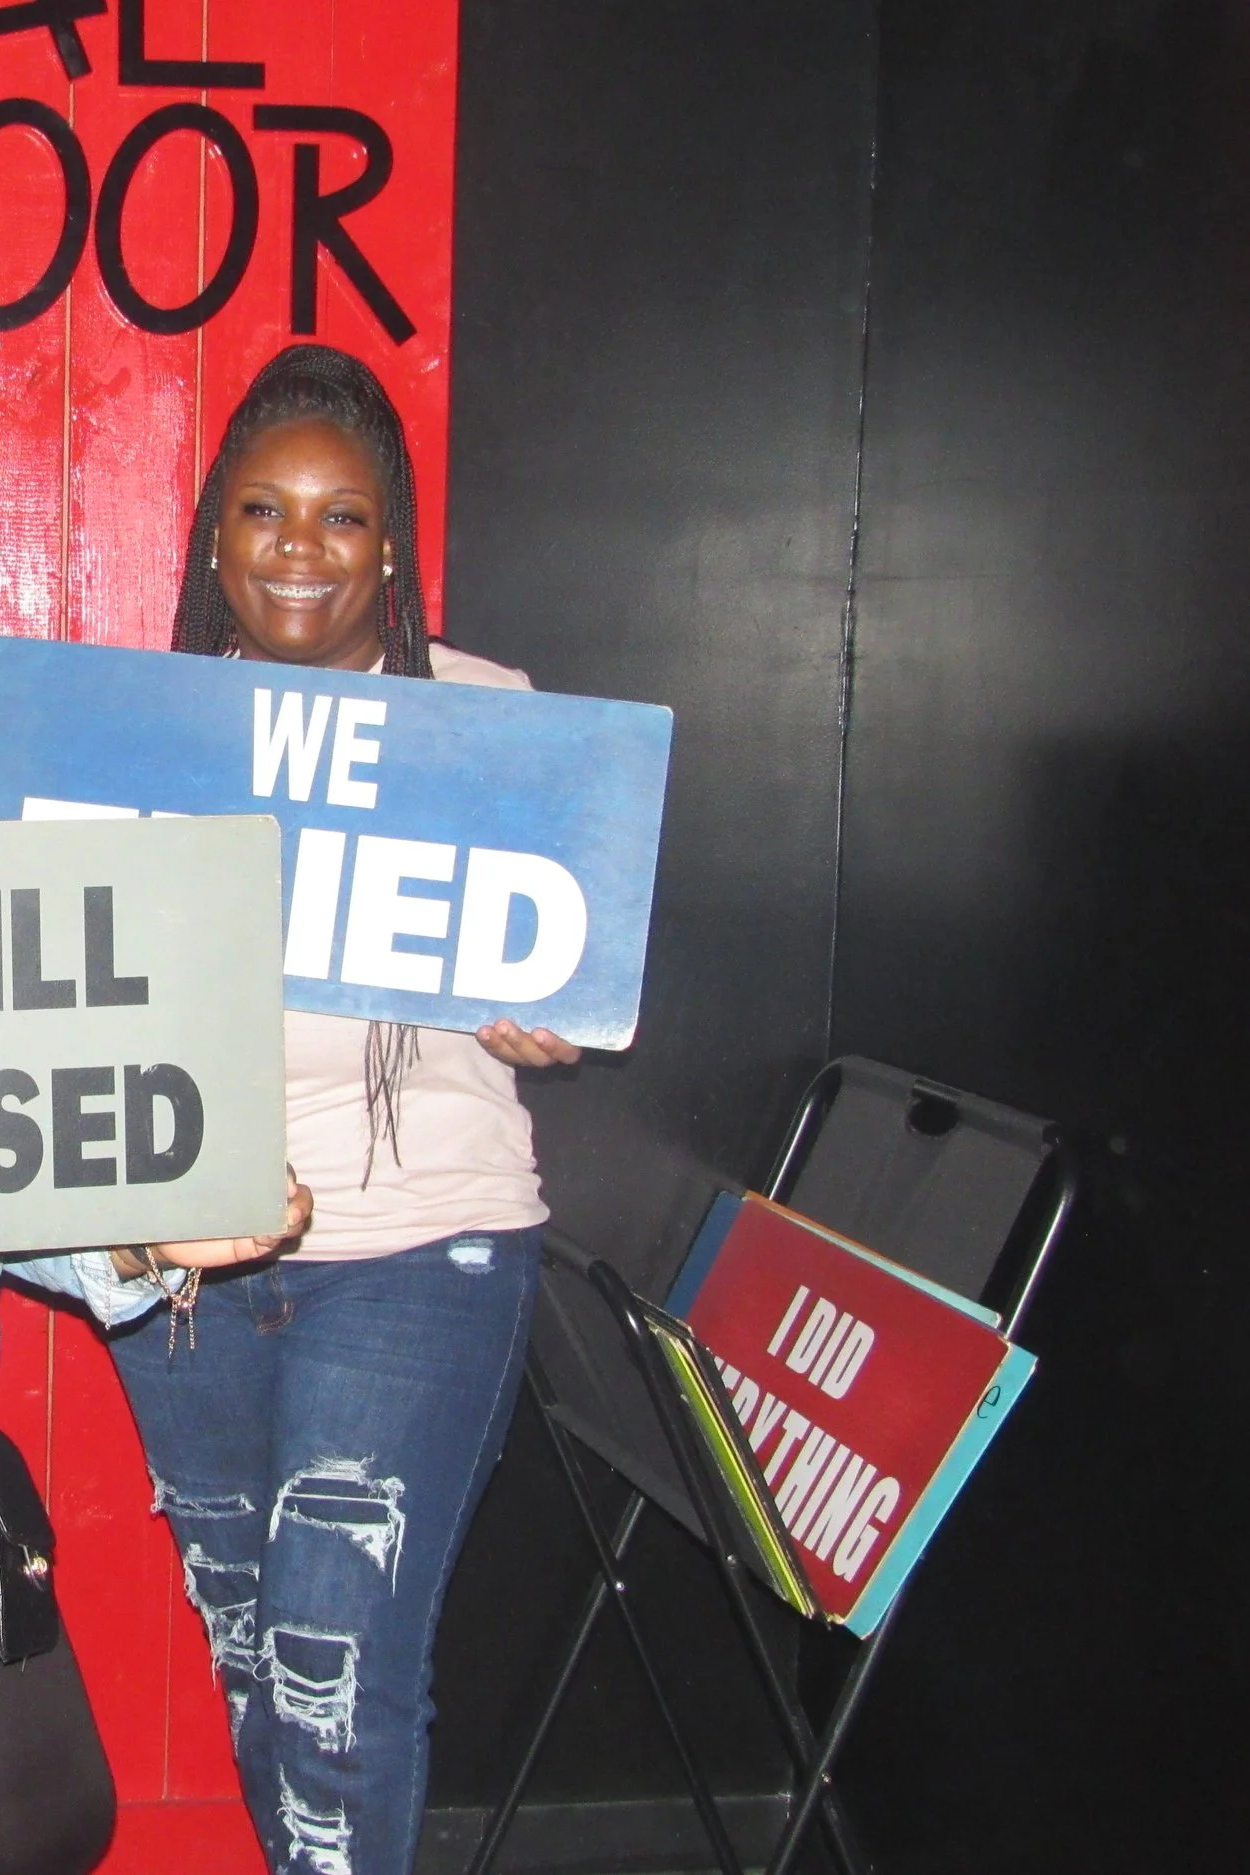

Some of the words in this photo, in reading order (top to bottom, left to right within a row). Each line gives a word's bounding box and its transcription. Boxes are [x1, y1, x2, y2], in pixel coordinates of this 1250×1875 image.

[253, 688, 387, 809] WE
[21, 797, 588, 1004] IED
[767, 1285, 810, 1357] I
[785, 1297, 875, 1399] DID
[714, 1356, 901, 1583] YTHING
